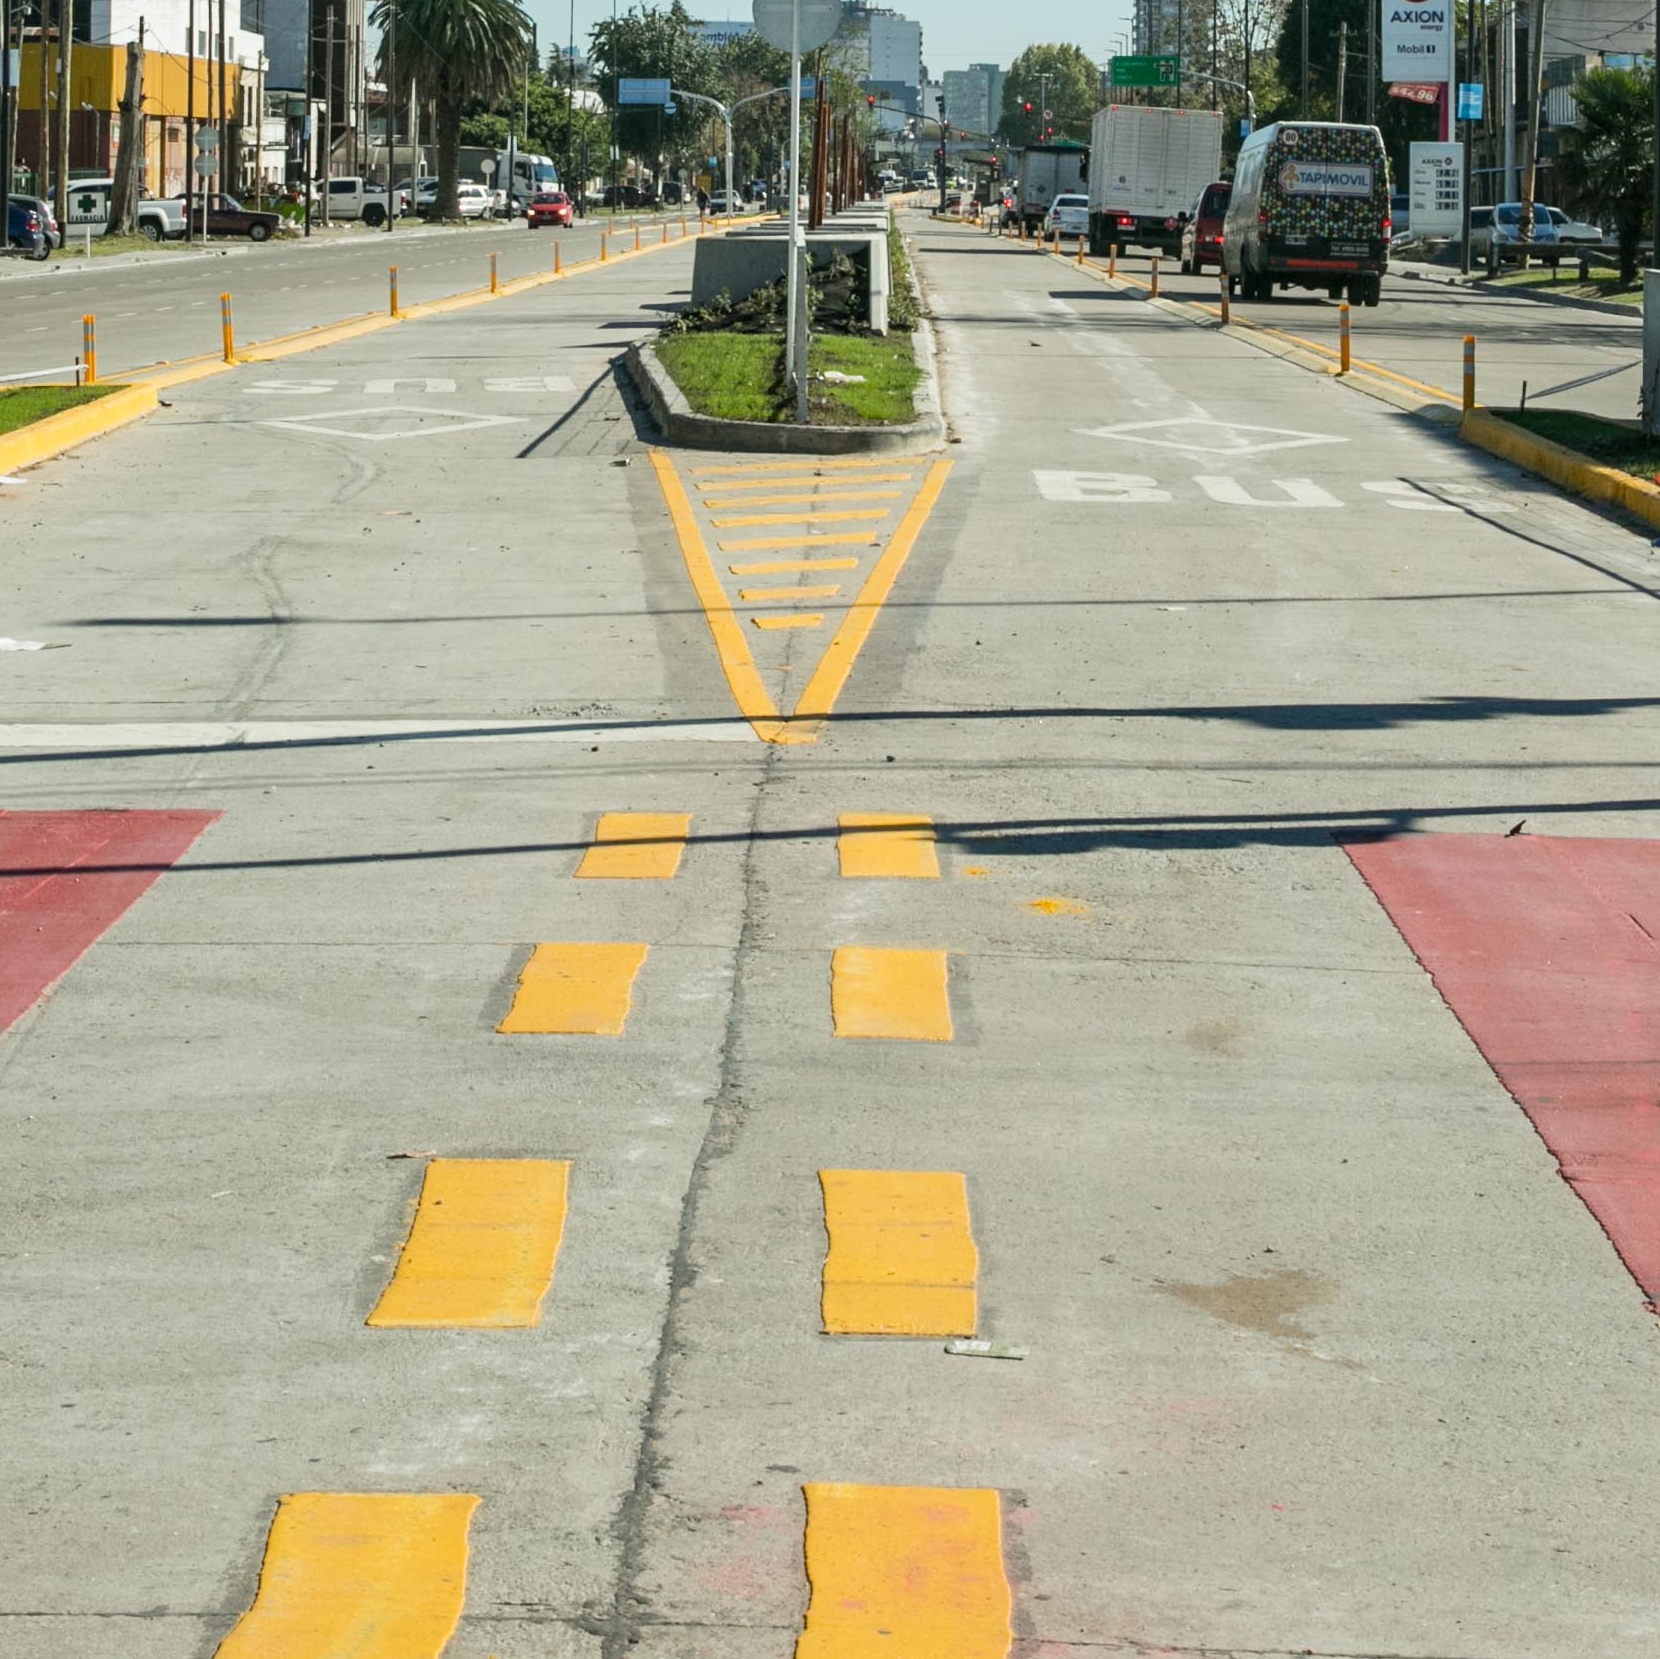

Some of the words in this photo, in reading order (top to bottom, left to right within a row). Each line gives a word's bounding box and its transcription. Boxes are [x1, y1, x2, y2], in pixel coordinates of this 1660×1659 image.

[1390, 10, 1444, 23] AXION
[1397, 44, 1425, 54] Mobil
[1299, 171, 1369, 187] TAPIMOVIL
[1030, 469, 1519, 513] BUS
